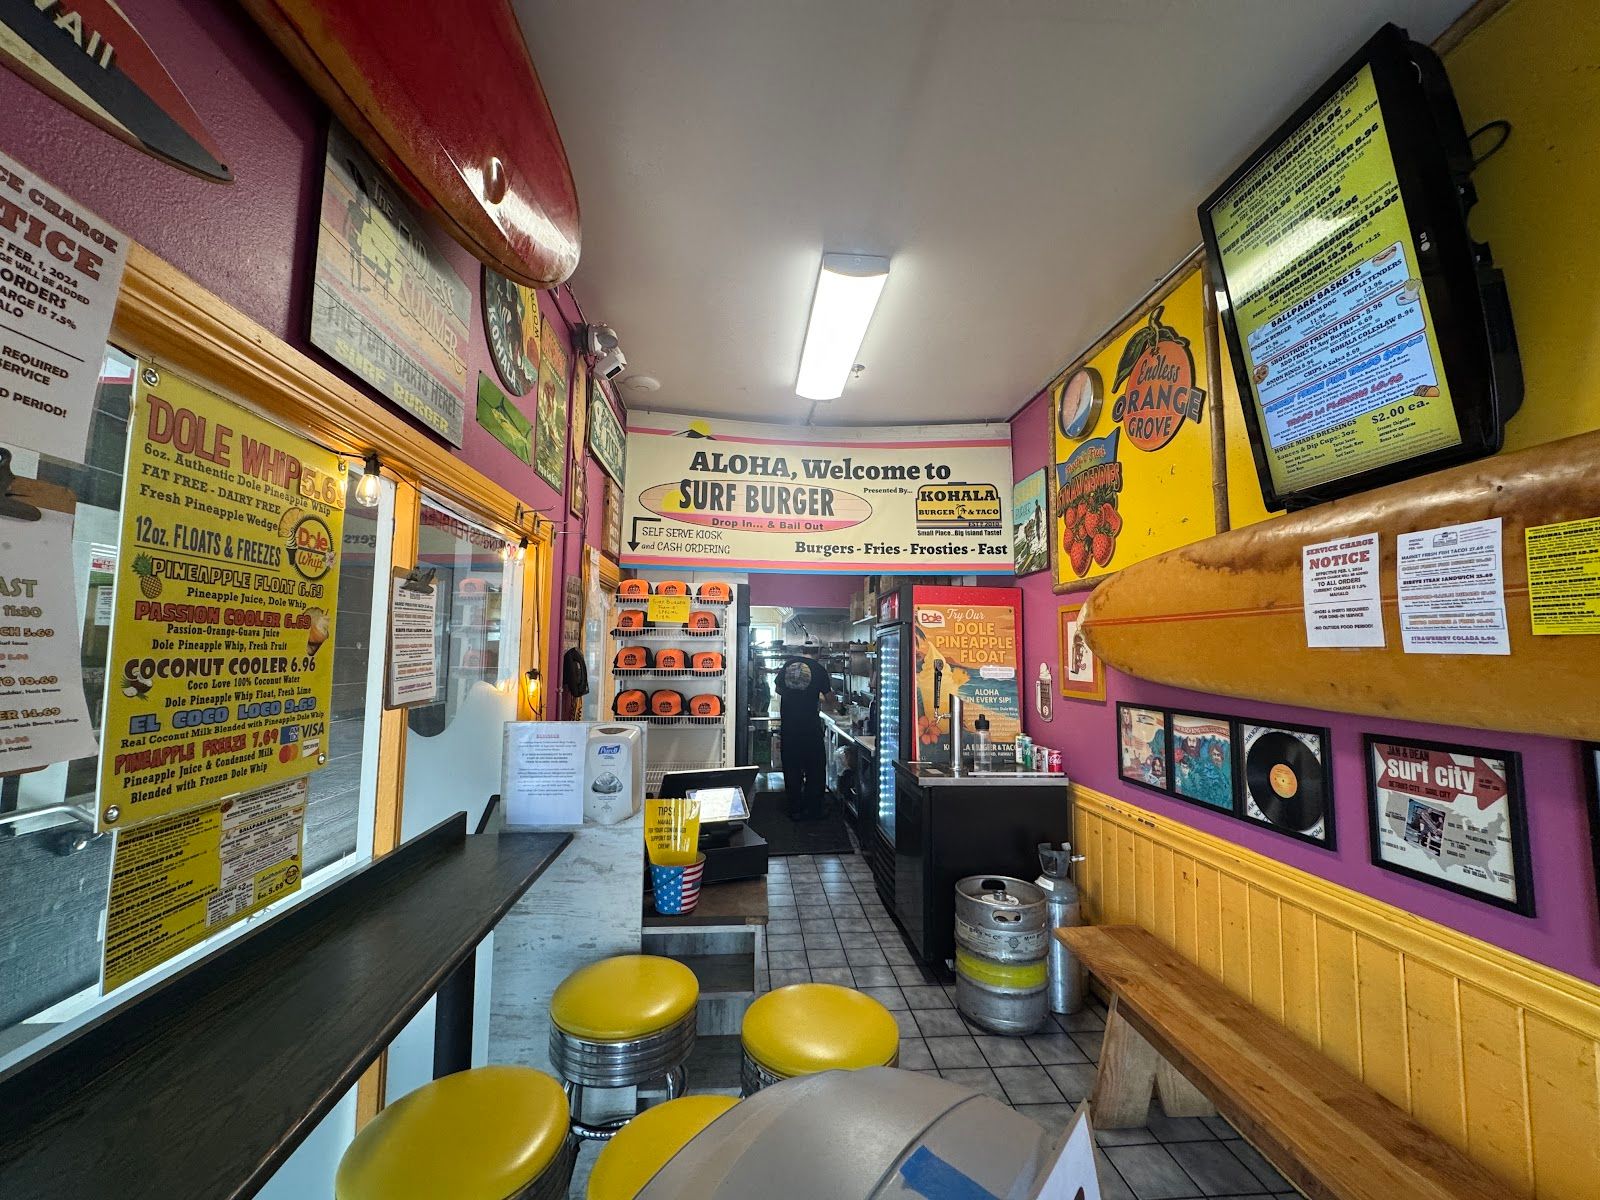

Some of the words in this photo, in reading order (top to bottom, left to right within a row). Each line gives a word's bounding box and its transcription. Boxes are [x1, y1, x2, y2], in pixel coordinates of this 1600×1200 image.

[1295, 143, 1353, 195] HAMBURGER
[1355, 123, 1378, 146] 8.96
[29, 189, 118, 254] CHARGE
[7, 243, 35, 264] FEB.
[39, 262, 46, 271] 1,
[50, 268, 78, 288] 2024
[1343, 280, 1369, 296] TRIPLE
[1369, 259, 1402, 281] TENDERS
[0, 268, 67, 309] ORDERS
[16, 261, 39, 279] WILL
[42, 276, 55, 286] BE
[56, 283, 90, 305] ADDED
[1272, 298, 1316, 327] BALLPARK
[1317, 268, 1362, 299] BASKETS
[38, 304, 48, 315] IS
[50, 311, 76, 330] 7.5%
[1310, 324, 1338, 345] FRENCH
[1340, 315, 1361, 332] FRIES
[488, 306, 515, 388] KOHALA
[2, 345, 69, 378] REQUIRED
[1137, 354, 1180, 385] Endless
[13, 392, 67, 417] PERIOD!
[1112, 384, 1205, 424] ORANGE
[1372, 406, 1404, 424] $2.00
[1408, 400, 1430, 412] ea.
[147, 394, 233, 468] DOLE
[1128, 416, 1172, 439] GROVE
[144, 442, 170, 460] 6oz.
[174, 453, 234, 482] Authentic
[237, 475, 261, 491] Dole
[264, 485, 308, 507] Pineapple
[311, 500, 330, 517] Whip
[689, 452, 798, 480] ALOHA,
[801, 458, 920, 480] Welcome
[925, 463, 951, 480] to
[142, 463, 170, 480] FAT
[174, 473, 208, 492] FREE
[218, 487, 252, 506] DAIRY
[256, 498, 280, 515] FREE
[680, 478, 736, 512] SURF
[746, 485, 834, 516] BURGER
[921, 490, 996, 501] KOHALA
[140, 483, 180, 504] Fresh
[185, 496, 244, 522] Pineapple
[247, 513, 278, 531] Wedge
[642, 527, 664, 537] SELF
[666, 528, 693, 538] SERVE
[695, 529, 723, 540] KIOSK
[712, 518, 738, 529] Drop
[742, 520, 763, 528] In...
[779, 521, 800, 530] Bail
[805, 522, 823, 531] Out
[136, 515, 168, 546] 12oz.
[174, 524, 221, 555] FLOATS
[224, 536, 233, 558] &
[237, 538, 280, 567] FREEZES
[298, 527, 327, 551] Dole
[641, 542, 655, 550] and
[657, 542, 682, 552] CASH
[685, 543, 730, 554] ORDERING
[795, 542, 854, 556] Burgers
[864, 543, 900, 554] Fries
[910, 542, 968, 555] Frosties
[978, 544, 1008, 555] Fast
[1307, 544, 1338, 555] SERVICE
[1340, 538, 1374, 550] CHARGE
[298, 552, 323, 572] Whip
[1309, 550, 1370, 570] NOTICE
[151, 558, 251, 589] PINEAPPLE
[254, 574, 295, 594] FLOAT
[298, 582, 323, 598] 6.69
[187, 587, 238, 602] Pineapple
[241, 593, 265, 606] Juice,
[268, 597, 286, 606] Dole
[288, 599, 306, 610] Whip
[134, 600, 220, 624] PASSION
[224, 608, 281, 628] COOLER
[284, 613, 311, 629] 6.69
[921, 613, 942, 623] Dole
[947, 608, 965, 622] Try
[965, 609, 985, 620] Our
[167, 624, 260, 638] Passion-Orange-Guava
[263, 629, 279, 638] Juice
[936, 635, 1013, 649] PINEAPPLE
[954, 623, 995, 636] DOLE
[125, 658, 224, 680] COCONUT
[229, 657, 287, 675] COOLER
[290, 657, 315, 672] 6.96
[960, 650, 1006, 663] FLOAT
[188, 680, 208, 690] Coco
[212, 680, 230, 688] Love
[255, 676, 282, 686] Coconut
[284, 675, 300, 683] Water
[976, 696, 998, 704] EVERY
[999, 696, 1011, 704] SIP!
[129, 713, 160, 735] EL
[172, 706, 229, 729] COCO
[238, 701, 281, 720] LOCO
[284, 697, 316, 714] 9.69
[301, 722, 324, 738] VISA
[115, 742, 195, 775] PINEAPPLE
[202, 733, 246, 758] FREEZE
[1410, 748, 1429, 760] DEAN
[124, 769, 175, 788] Pineapple
[179, 765, 202, 779] Juice
[206, 761, 212, 769] &
[216, 752, 255, 768] Condensed
[258, 748, 273, 757] Milk
[1388, 759, 1429, 784] surf
[1435, 765, 1475, 794] city
[130, 784, 172, 804] Blended
[176, 779, 196, 792] with
[200, 772, 228, 787] Frozen
[231, 767, 248, 778] Dole
[250, 763, 268, 774] Whip
[1410, 784, 1420, 793] CITY
